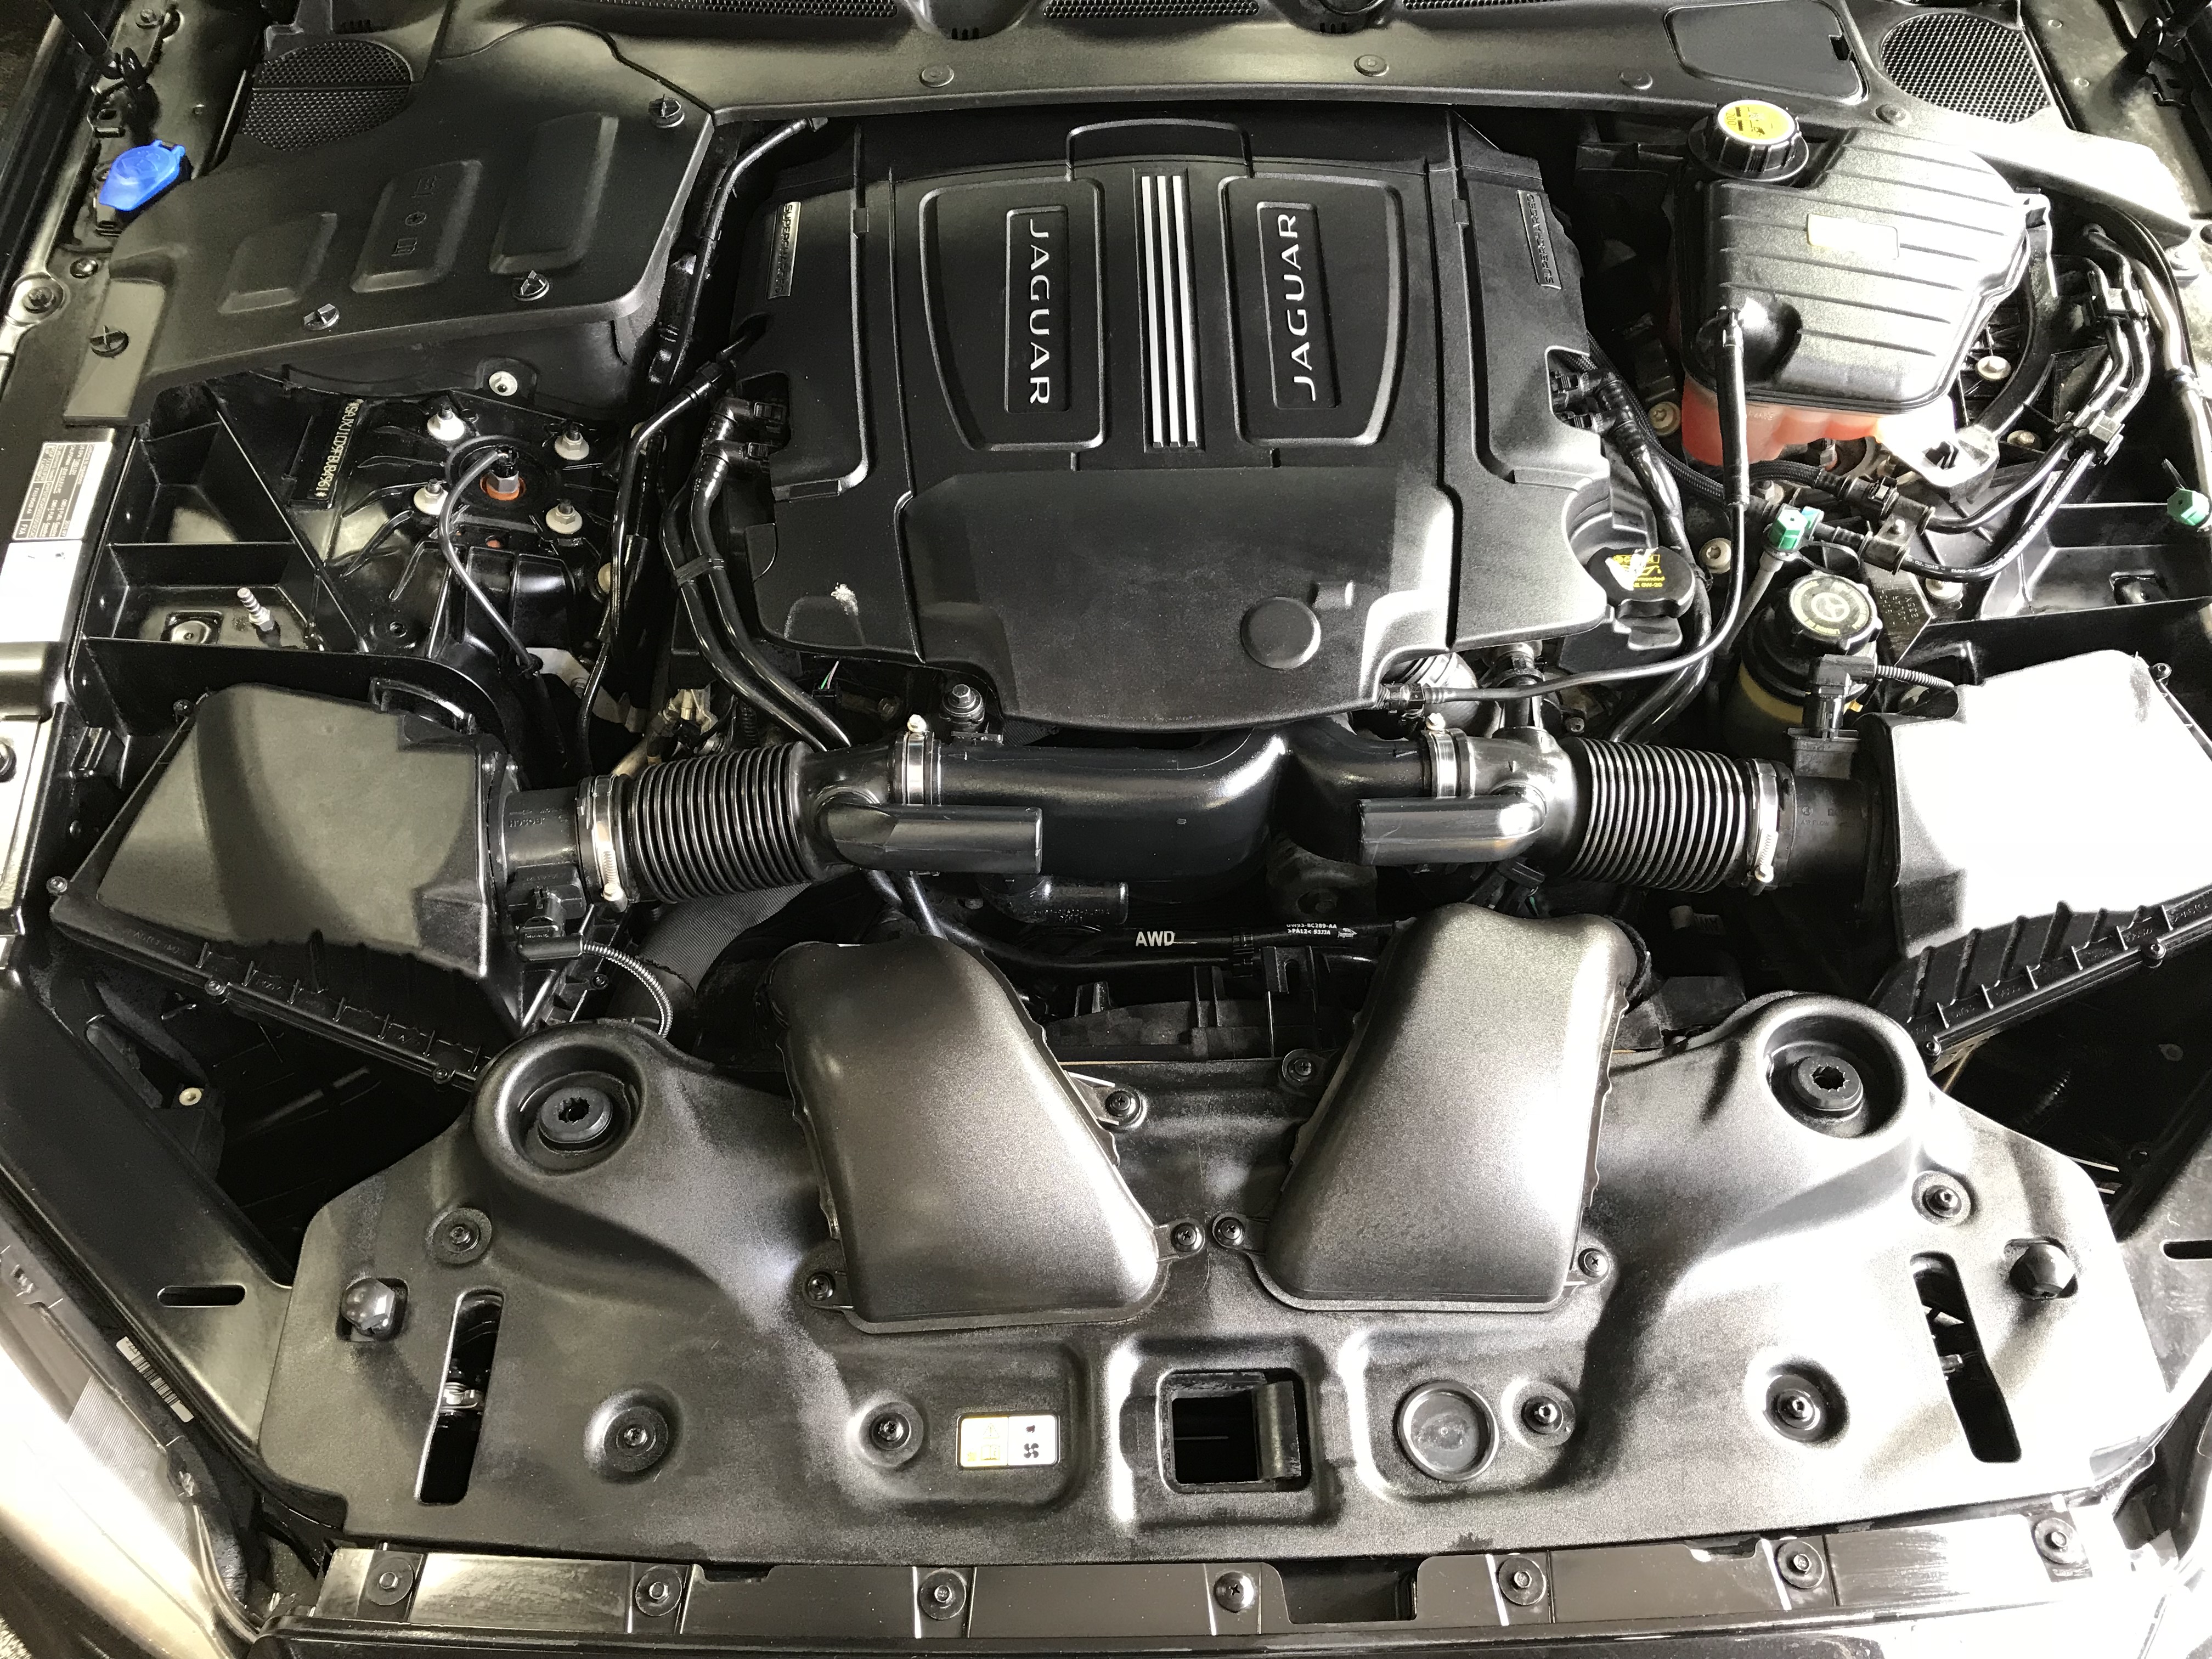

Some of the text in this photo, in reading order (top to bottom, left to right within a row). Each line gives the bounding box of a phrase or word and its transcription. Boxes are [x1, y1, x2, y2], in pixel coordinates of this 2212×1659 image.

[1527, 194, 1554, 284] SUPERCHARGED
[1029, 217, 1050, 405] JAGUAR
[1277, 214, 1316, 402] JAGUAR
[18, 524, 29, 534] FXA
[1135, 930, 1176, 947] AWD
